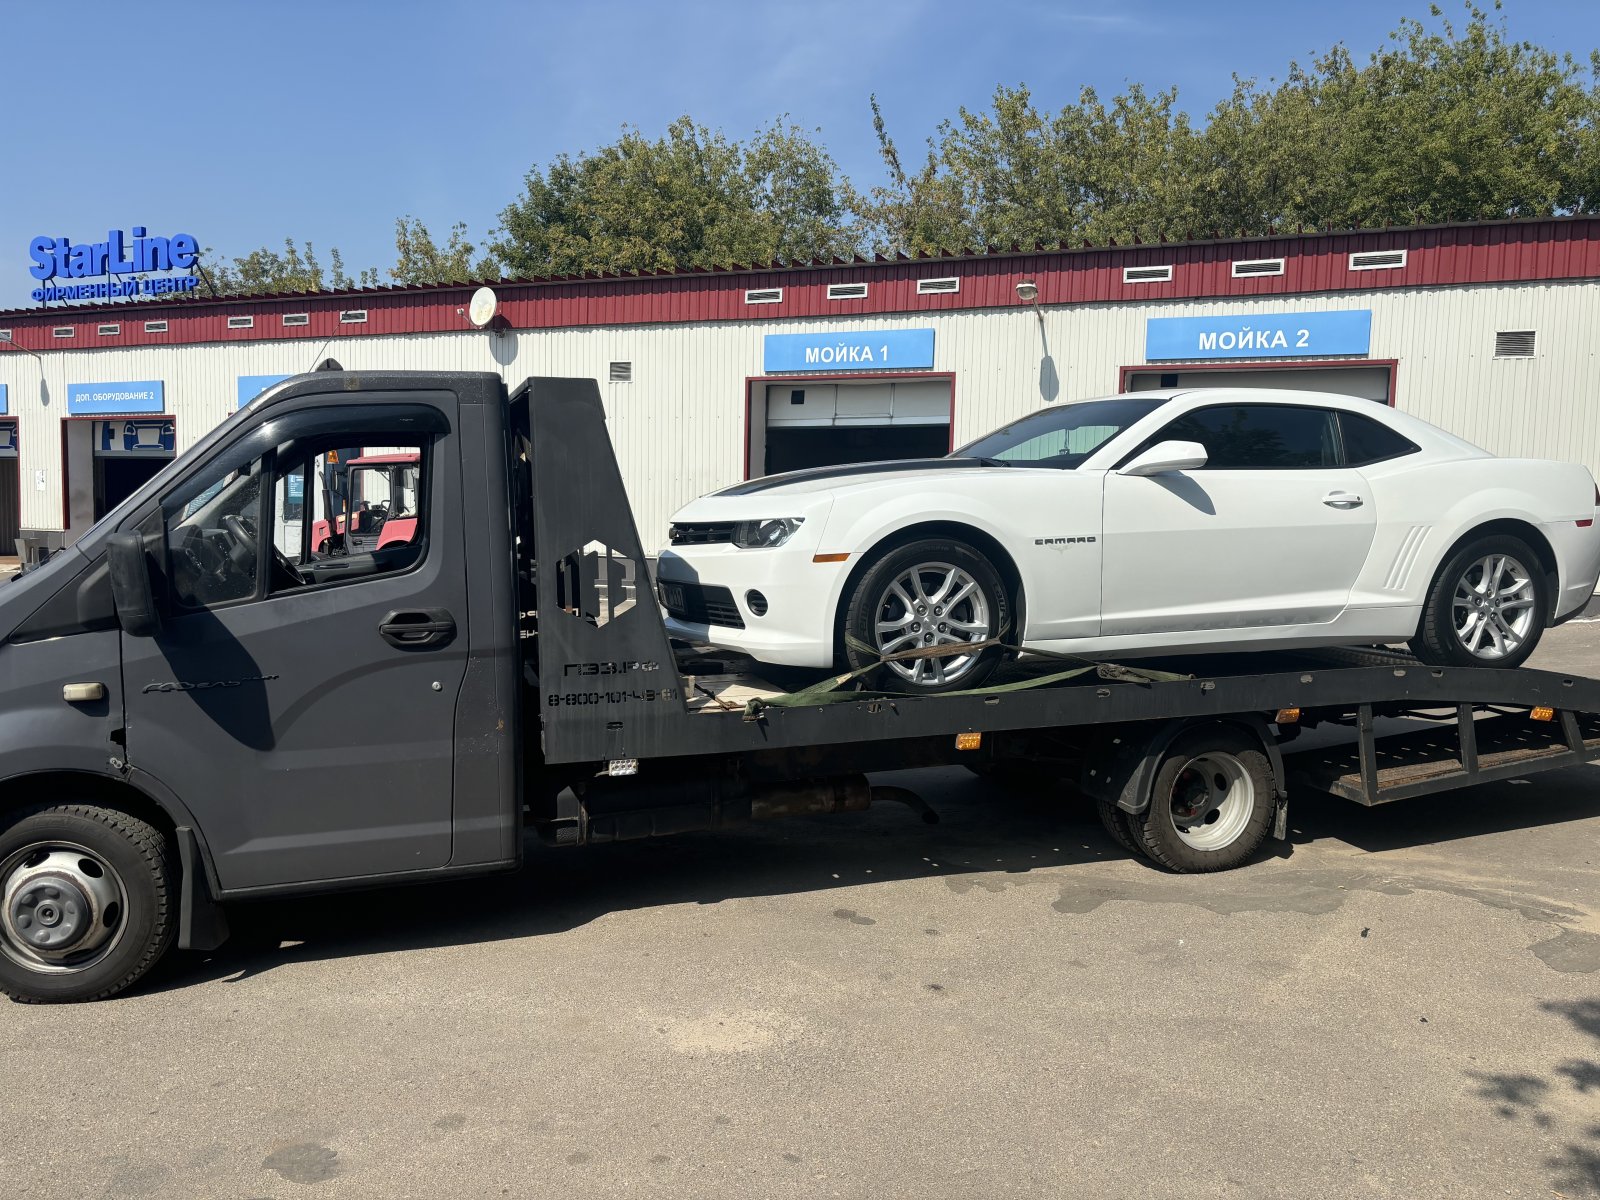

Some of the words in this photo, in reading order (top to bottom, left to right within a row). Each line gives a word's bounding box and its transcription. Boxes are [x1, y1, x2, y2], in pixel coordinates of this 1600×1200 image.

[29, 226, 200, 281] StarLine
[31, 276, 139, 302] ФИРМЕННЫЙ
[143, 275, 199, 297] ЦЕНТР
[1199, 326, 1288, 351] МОЙКА
[1295, 329, 1310, 348] 2
[805, 342, 874, 363] МОЙКА
[880, 345, 888, 361] 1
[75, 394, 91, 402] ДОП.
[93, 391, 148, 401] ОБОРУДОВАНИЕ
[149, 391, 154, 400] 2
[1034, 536, 1096, 545] CAMARO
